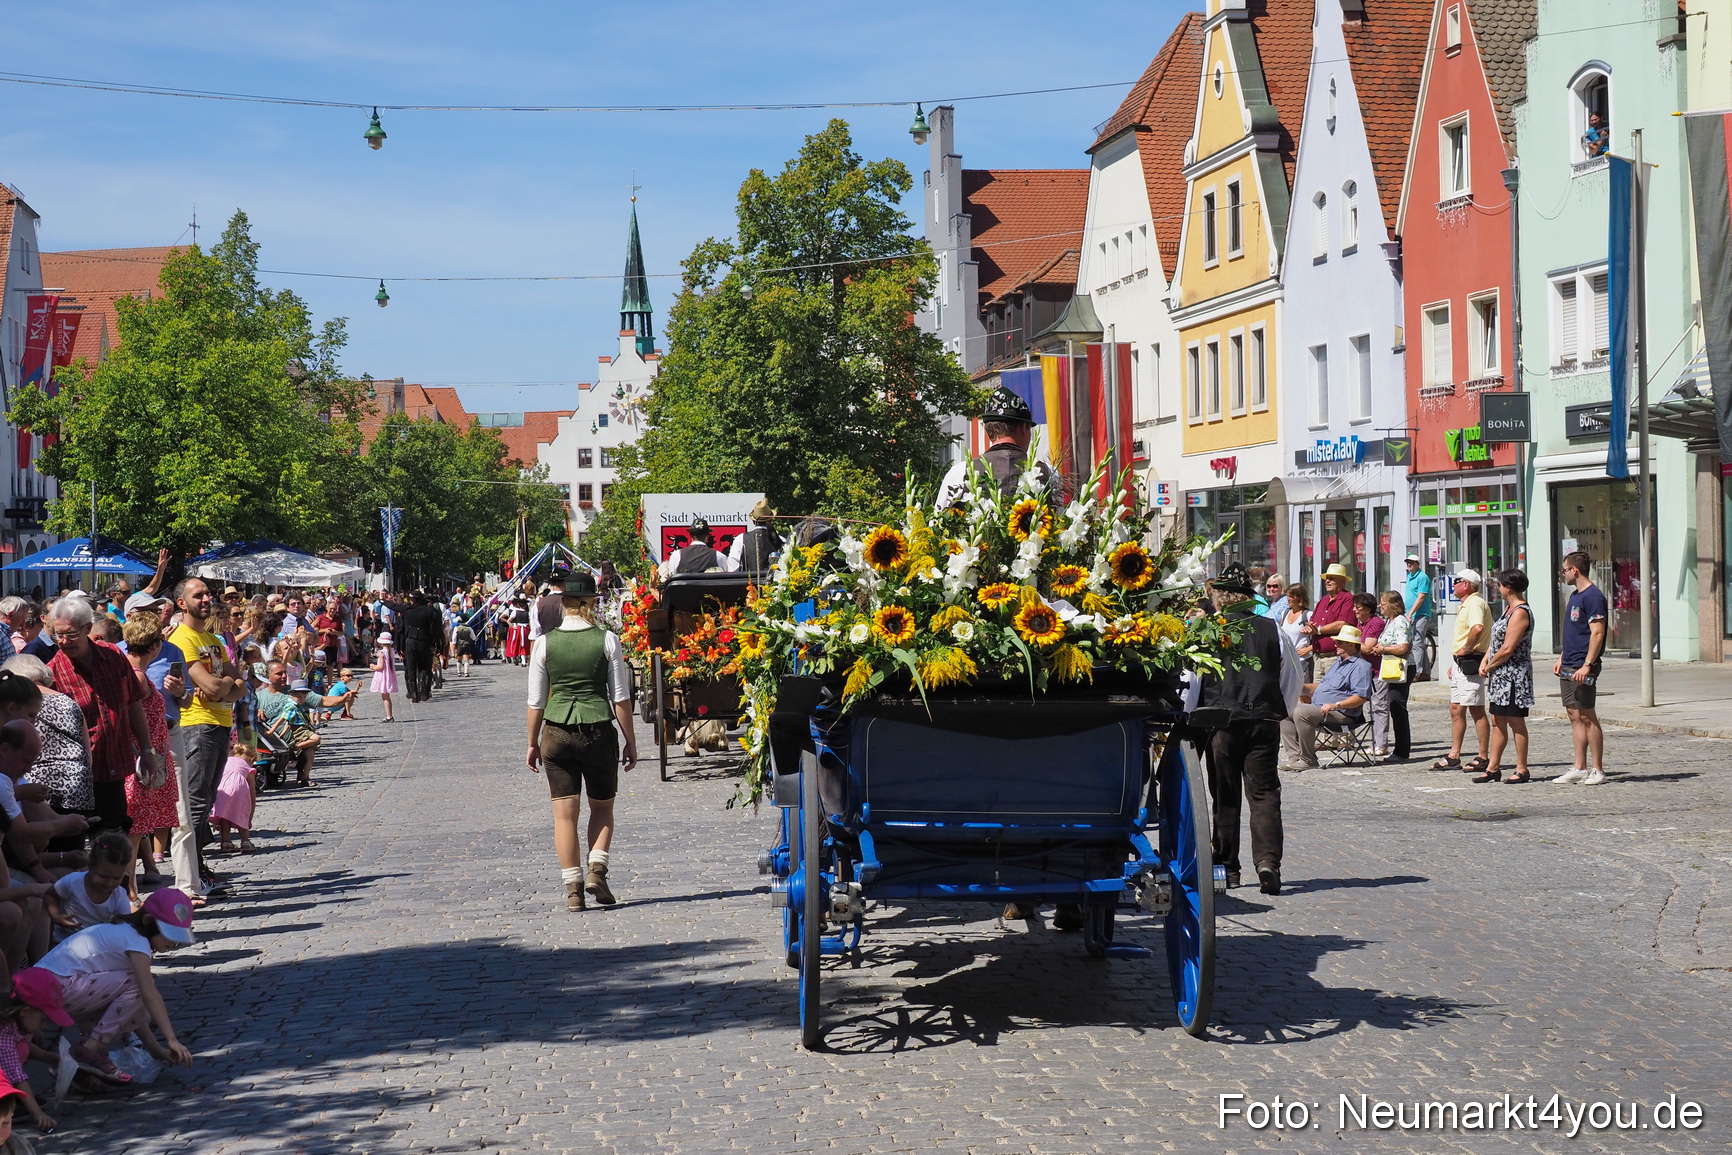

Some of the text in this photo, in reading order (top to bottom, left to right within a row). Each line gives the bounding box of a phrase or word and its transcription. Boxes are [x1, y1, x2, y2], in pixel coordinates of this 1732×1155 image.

[1487, 417, 1526, 431] BONITA
[1158, 483, 1169, 494] EC
[660, 511, 748, 523] Stadt Neumarkt
[1569, 526, 1598, 537] BONITA
[1576, 543, 1598, 553] ONITA
